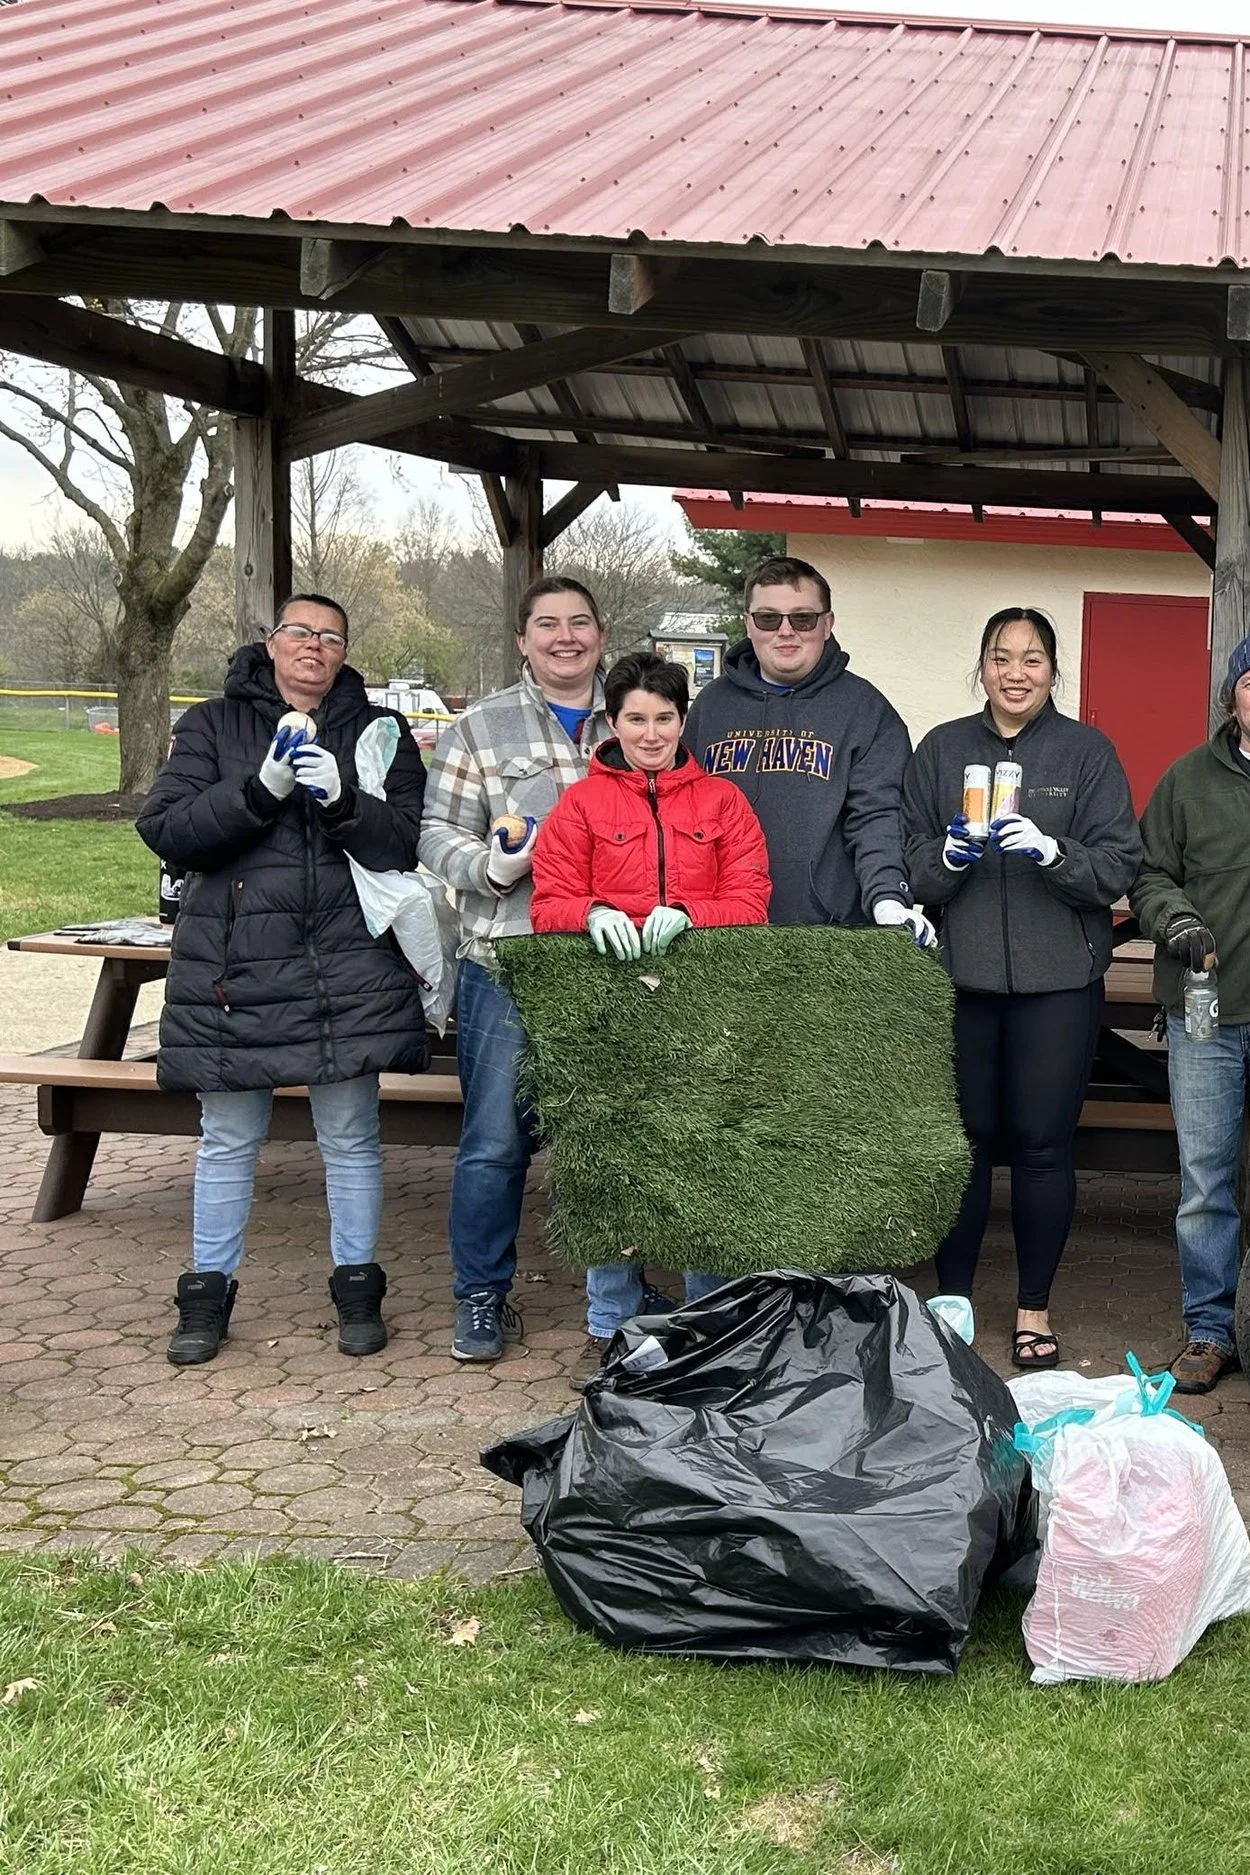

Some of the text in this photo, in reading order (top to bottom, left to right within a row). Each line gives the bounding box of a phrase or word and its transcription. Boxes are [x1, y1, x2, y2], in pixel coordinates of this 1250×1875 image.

[801, 731, 815, 739] OF
[703, 737, 834, 780] NEW HAVEN
